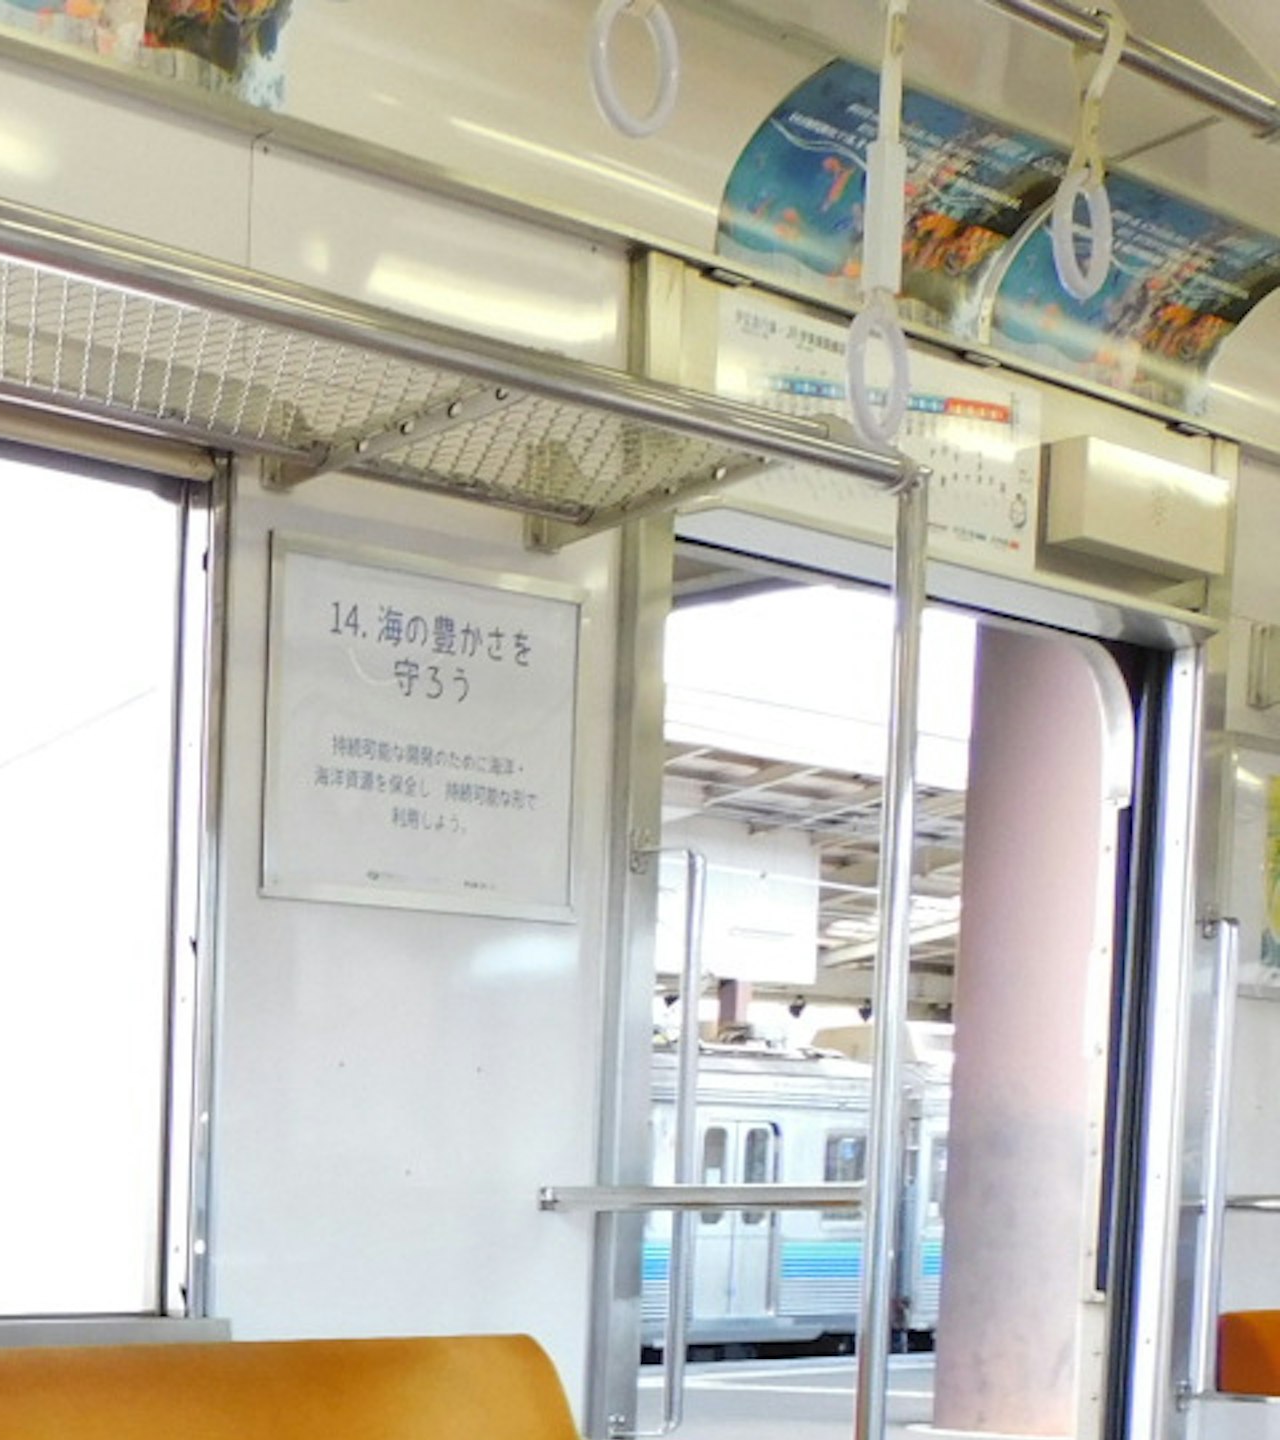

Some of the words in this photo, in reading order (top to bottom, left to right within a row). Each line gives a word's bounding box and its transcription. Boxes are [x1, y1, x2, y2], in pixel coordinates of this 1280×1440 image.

[377, 604, 532, 667] 海の豊かさを
[393, 658, 471, 702] 守ろう
